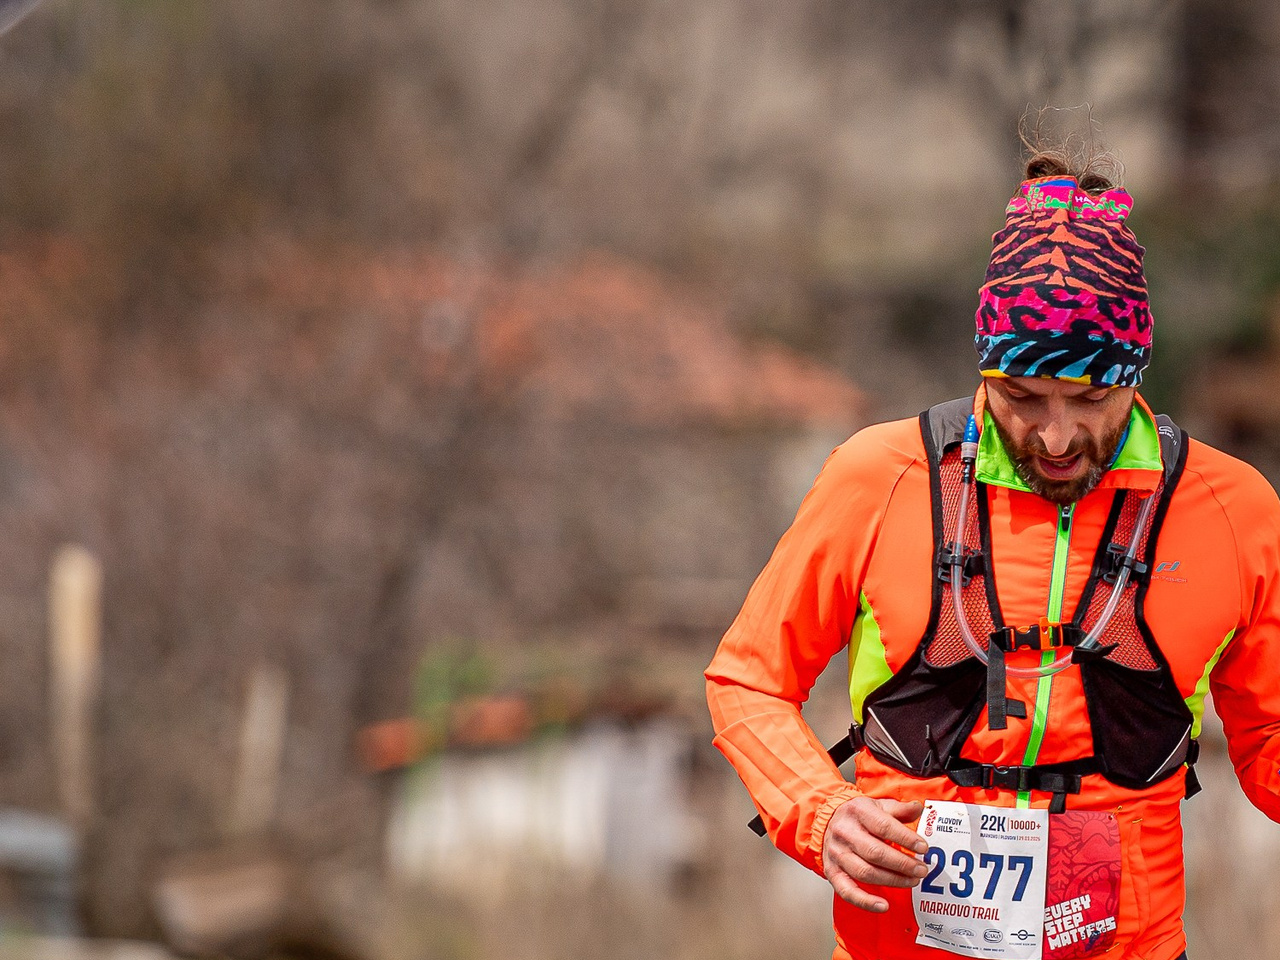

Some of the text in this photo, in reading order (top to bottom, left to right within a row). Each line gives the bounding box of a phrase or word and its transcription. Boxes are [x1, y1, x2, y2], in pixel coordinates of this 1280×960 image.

[936, 824, 953, 833] HILLS
[937, 816, 963, 826] PLOVDIV
[980, 814, 1006, 832] 22K
[1010, 819, 1041, 831] 1000D+
[920, 846, 1034, 902] 2377
[919, 900, 1000, 921] MARKOVO TRAIL
[1044, 894, 1091, 922] EVERY
[1044, 912, 1084, 936] STEP
[1047, 916, 1117, 951] MATTERS
